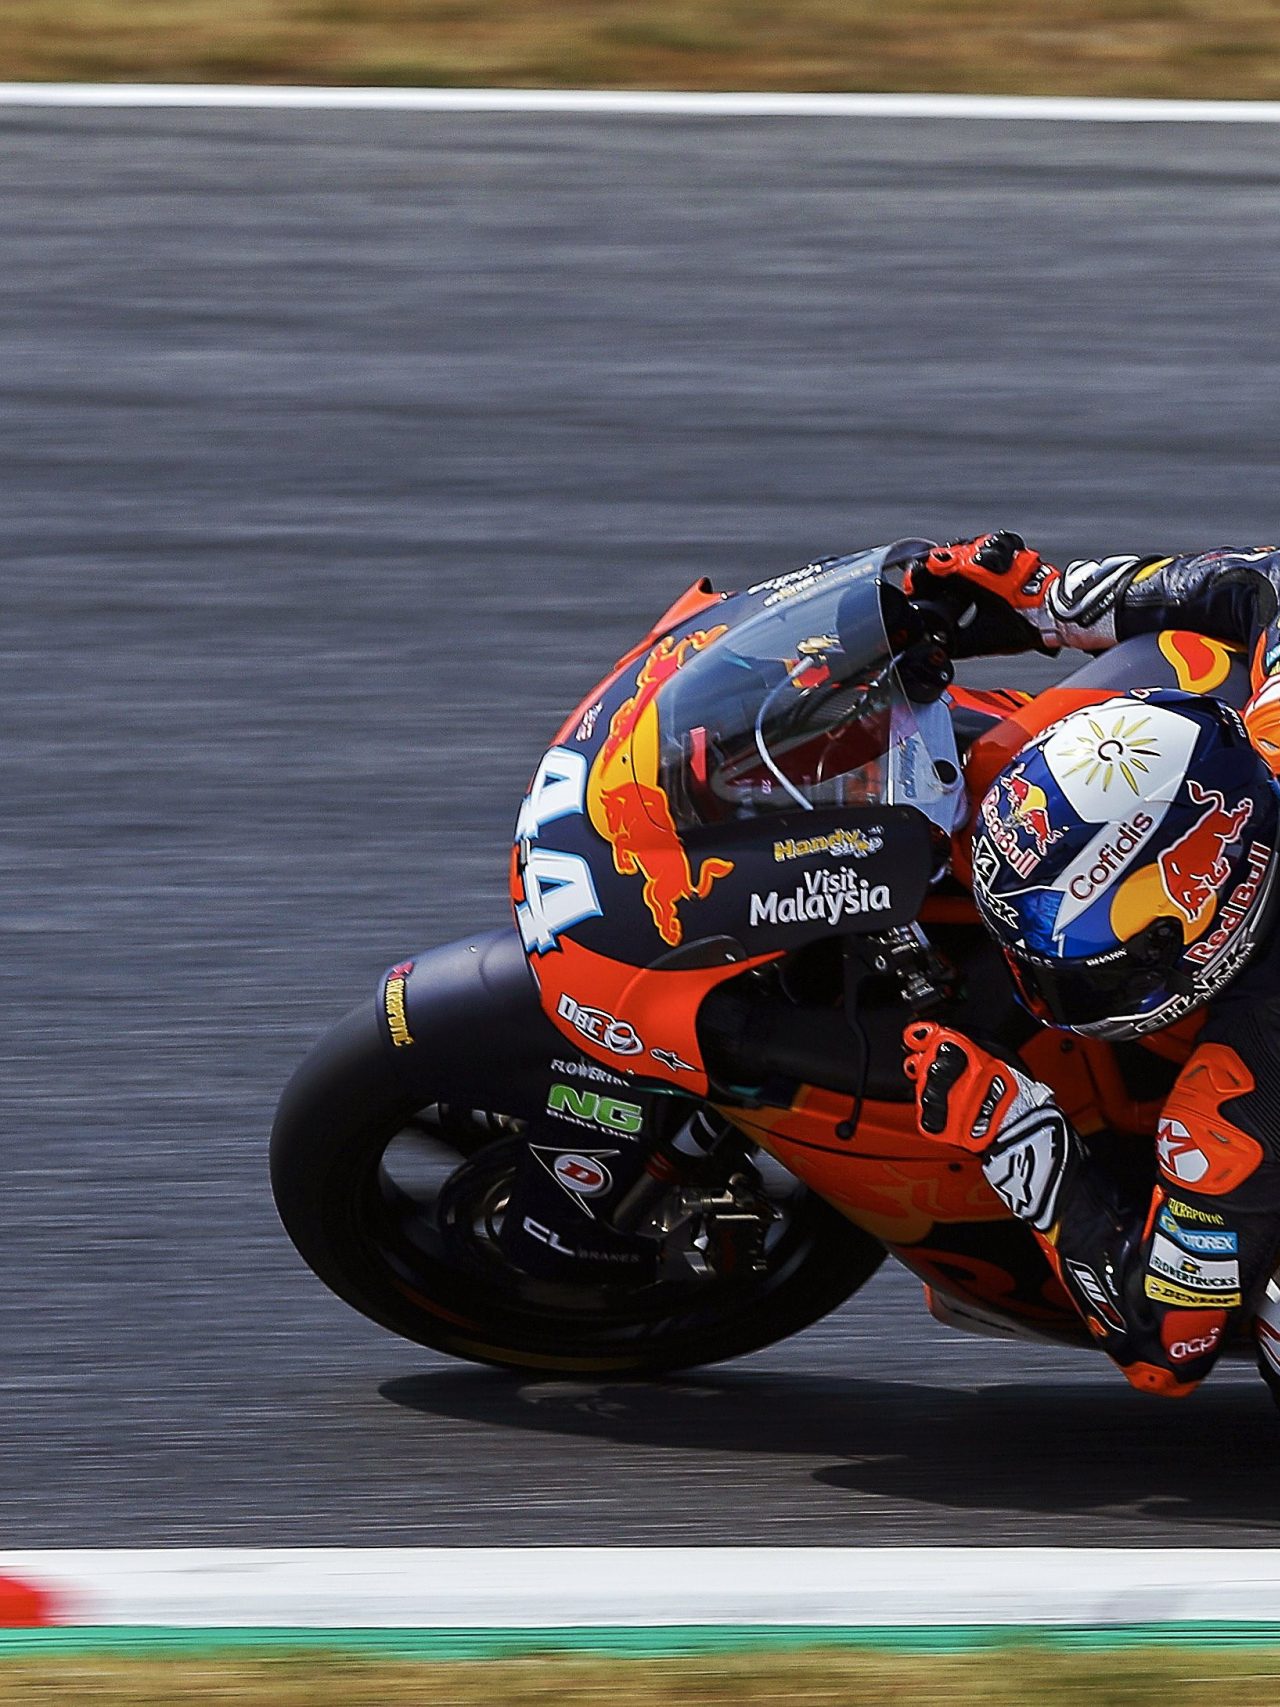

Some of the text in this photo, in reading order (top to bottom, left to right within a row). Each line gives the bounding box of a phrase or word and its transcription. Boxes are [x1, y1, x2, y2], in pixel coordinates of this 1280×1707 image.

[515, 745, 604, 954] 44
[996, 828, 1041, 879] Bull
[1070, 812, 1153, 901] Cofidis
[750, 879, 892, 926] Malaysia
[804, 866, 857, 895] Visit
[1183, 906, 1244, 965] Red
[1228, 841, 1271, 911] Bull
[548, 1083, 643, 1132] NG
[523, 1216, 640, 1263] CL BRAKES
[1160, 1287, 1237, 1304] DUNLOP
